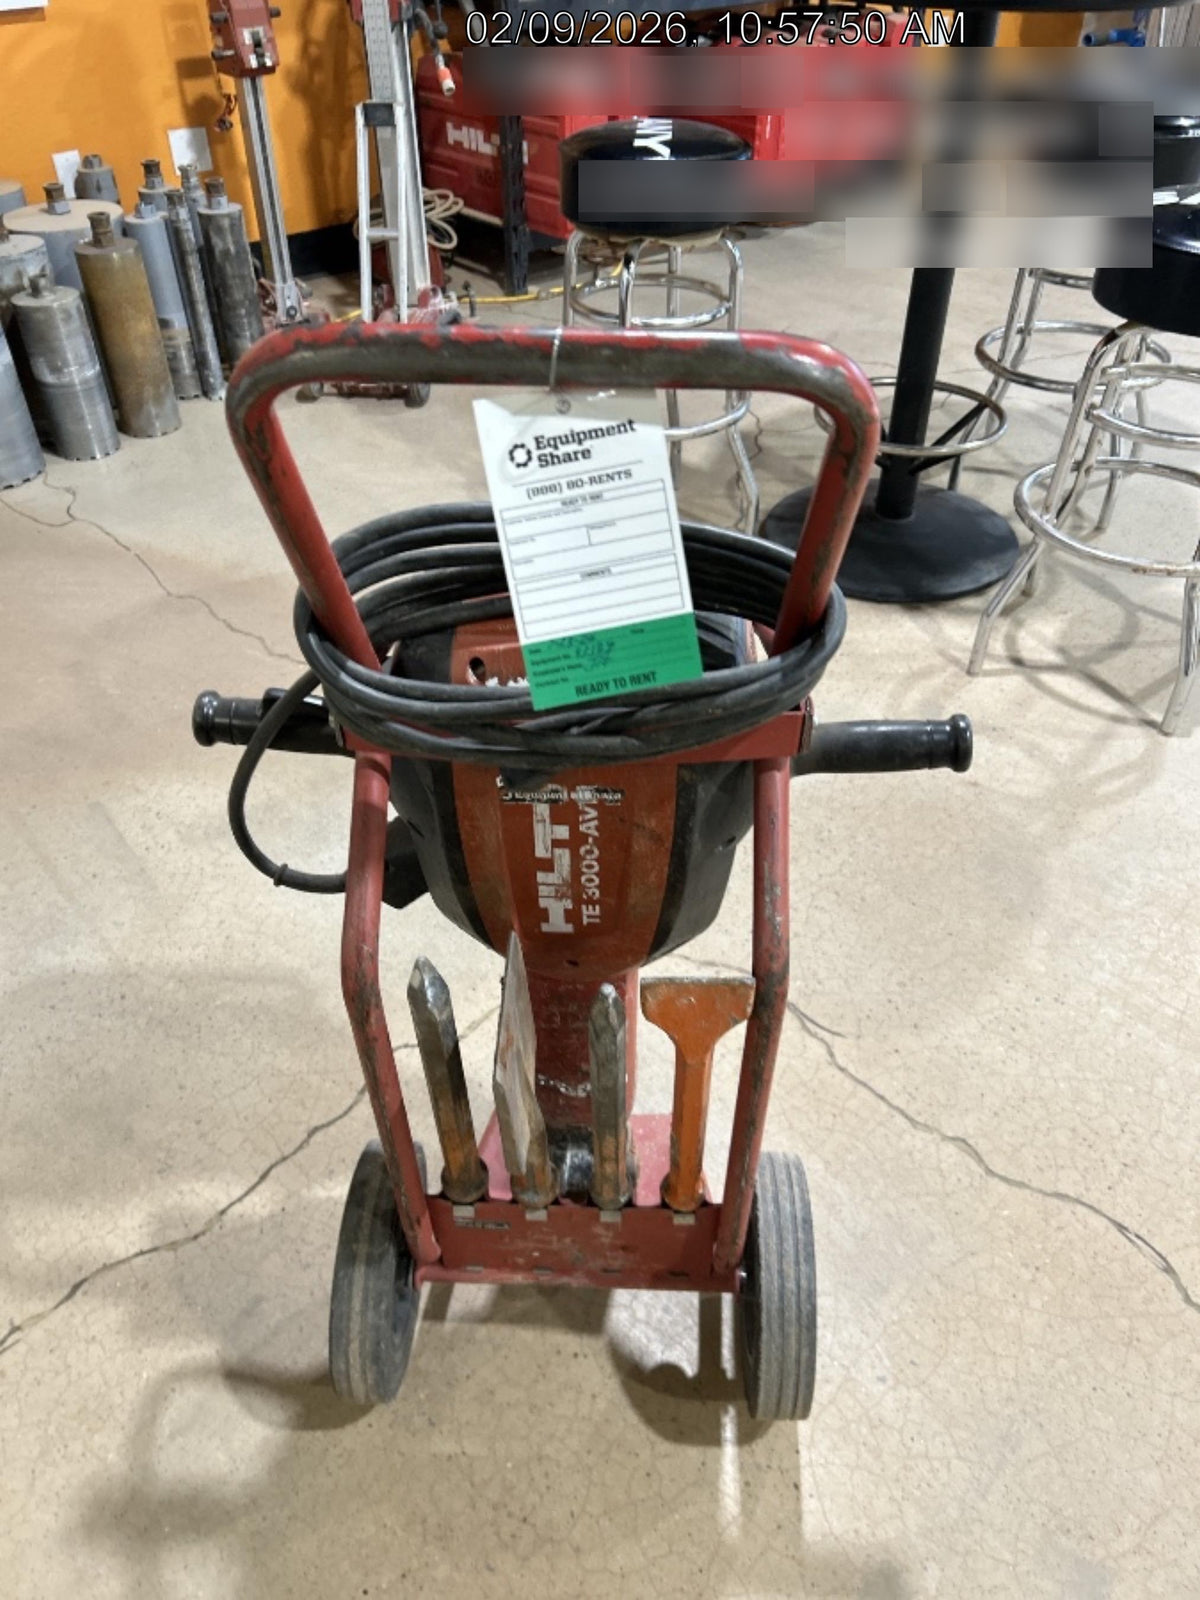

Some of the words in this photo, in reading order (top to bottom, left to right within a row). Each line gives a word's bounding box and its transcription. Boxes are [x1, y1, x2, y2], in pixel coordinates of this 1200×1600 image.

[446, 122, 529, 165] HILI
[533, 419, 637, 451] Equipment
[536, 447, 593, 469] Share
[574, 680, 611, 697] READY
[613, 677, 628, 690] TO
[629, 671, 658, 686] RENT
[533, 800, 575, 933] HILT
[581, 903, 601, 925] TE
